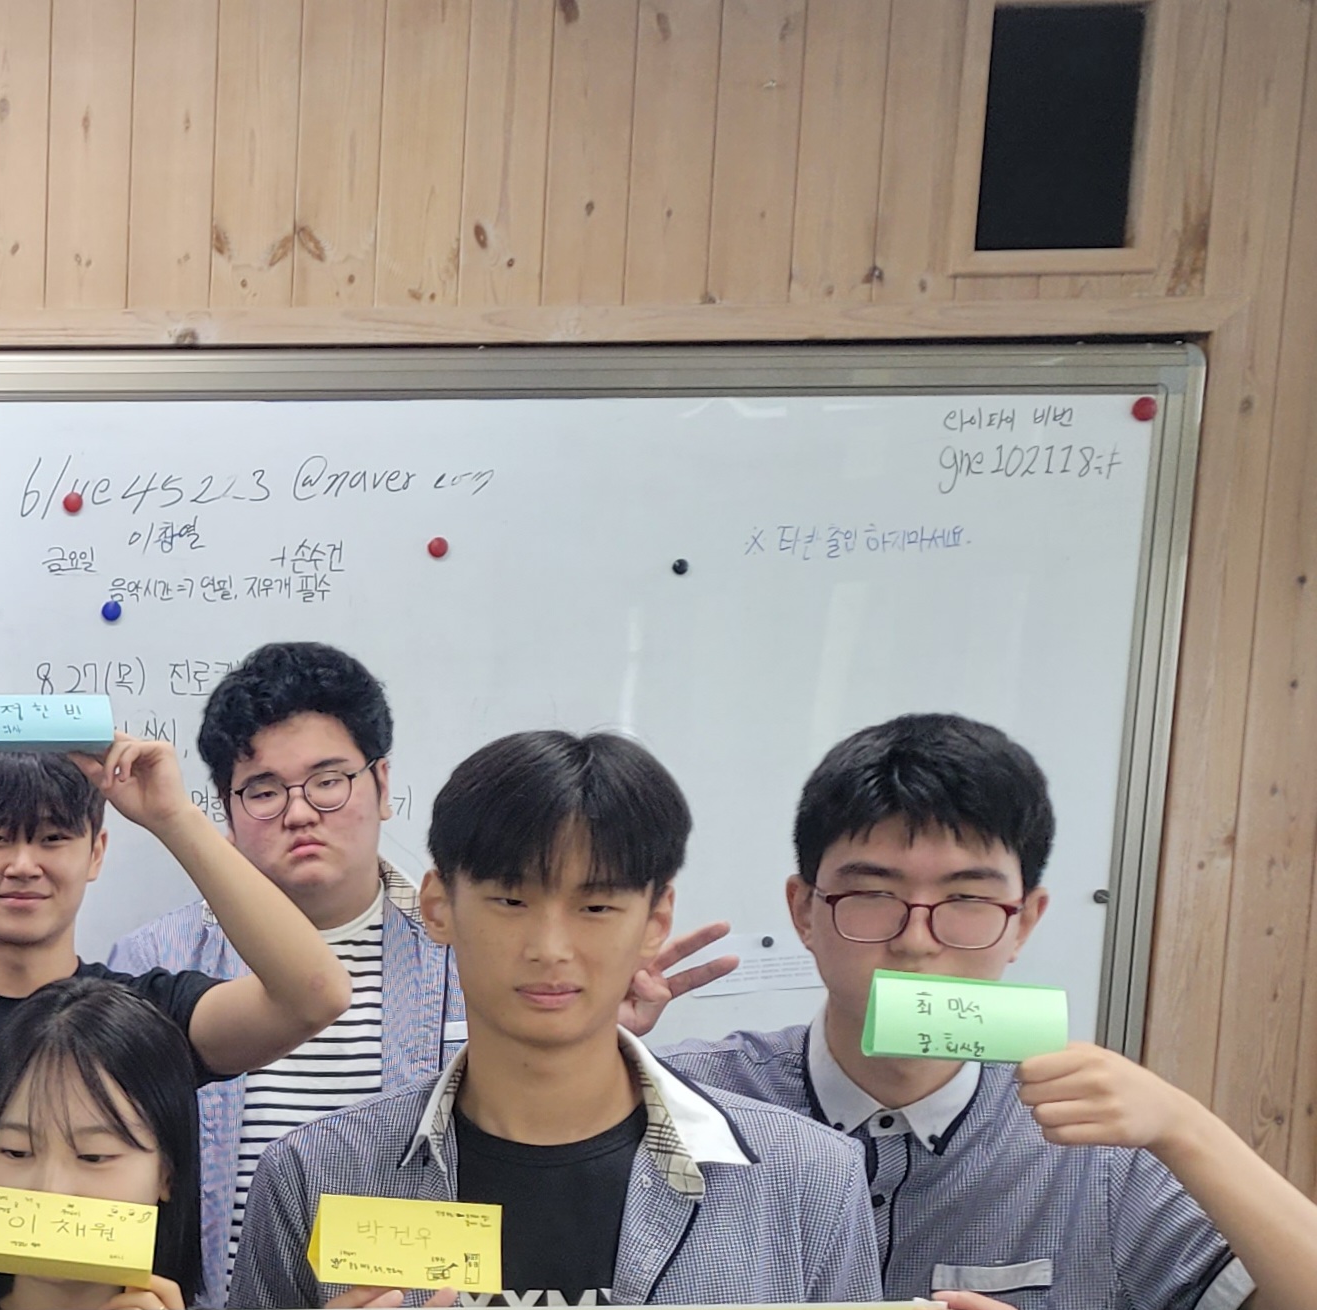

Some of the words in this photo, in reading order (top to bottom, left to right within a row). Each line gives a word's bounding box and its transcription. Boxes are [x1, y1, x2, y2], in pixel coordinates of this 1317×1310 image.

[1033, 405, 1073, 428] 비번
[42, 547, 97, 575] 금요일
[243, 576, 291, 600] 지우개
[296, 573, 332, 603] 필수
[356, 1220, 433, 1250] 박건우
